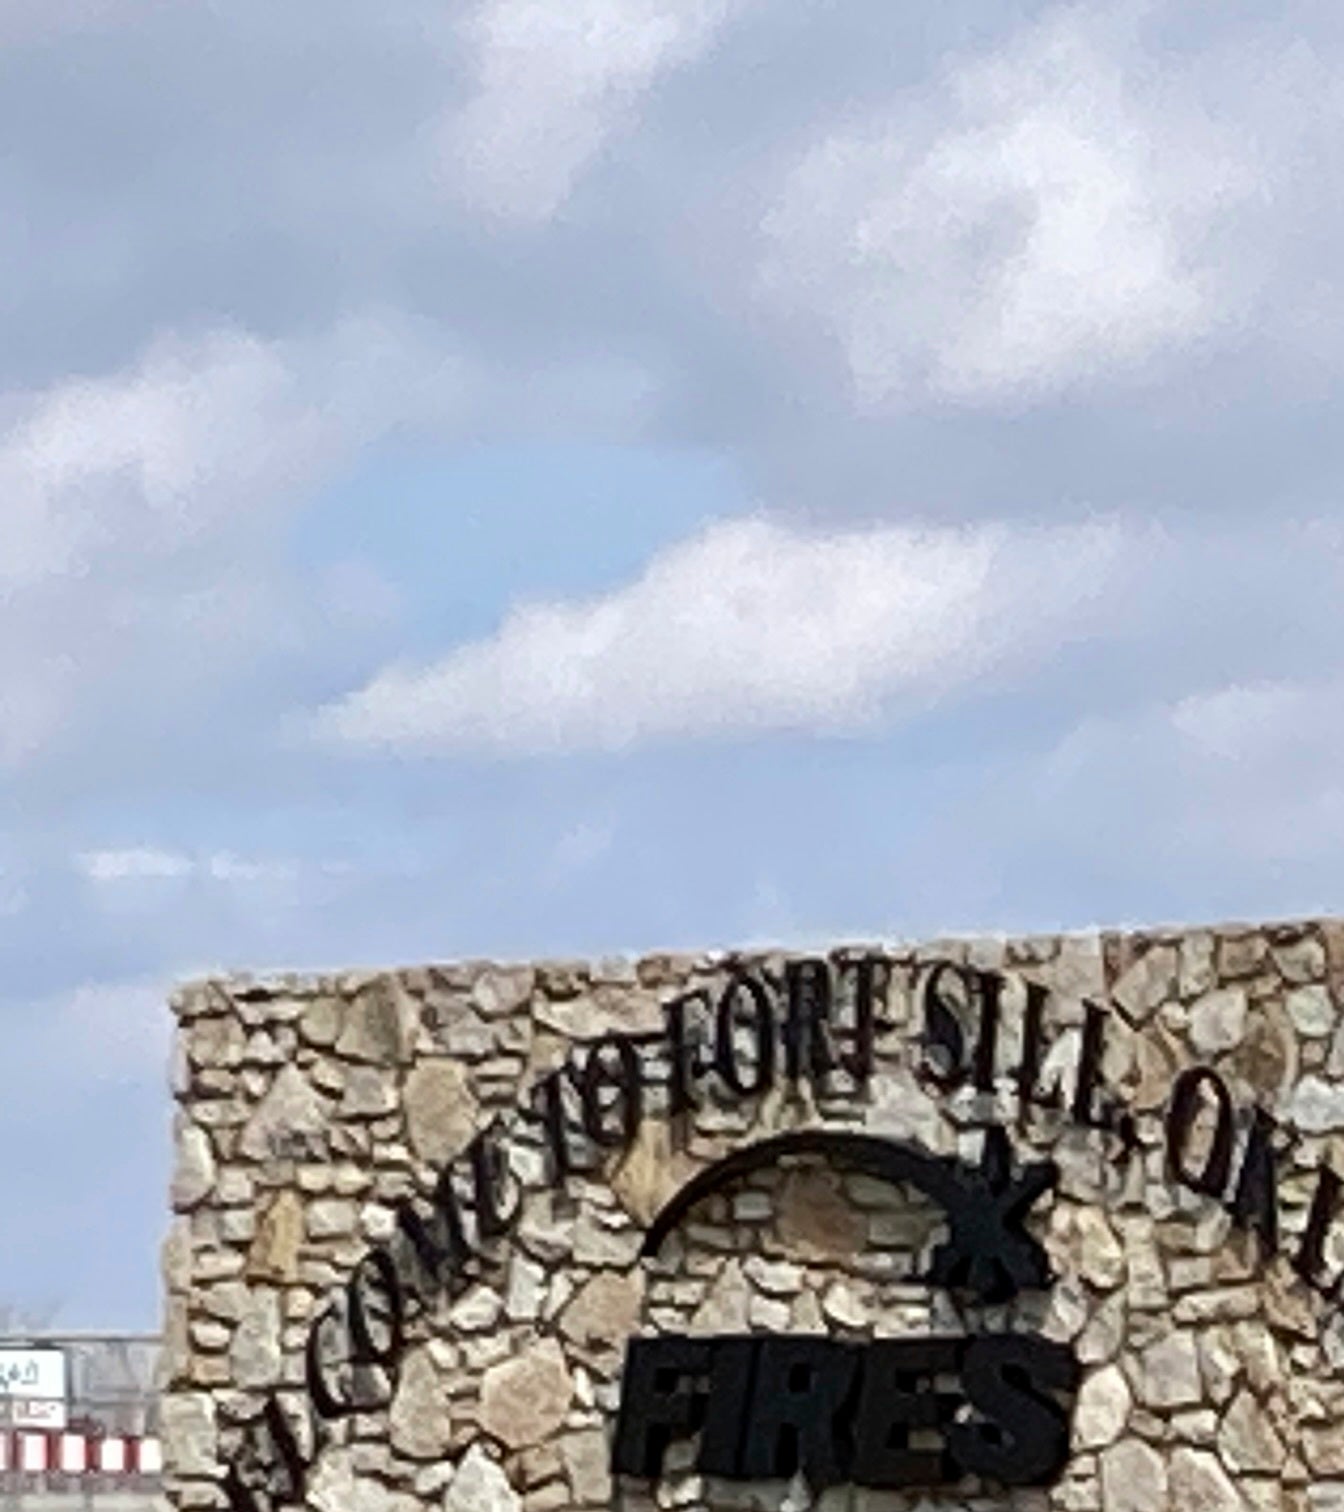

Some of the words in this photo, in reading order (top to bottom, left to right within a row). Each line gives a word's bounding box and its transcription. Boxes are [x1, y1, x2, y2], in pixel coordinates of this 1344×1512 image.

[530, 1035, 640, 1188] TO
[663, 955, 914, 1118] FORT
[610, 1332, 1080, 1490] FIRES
